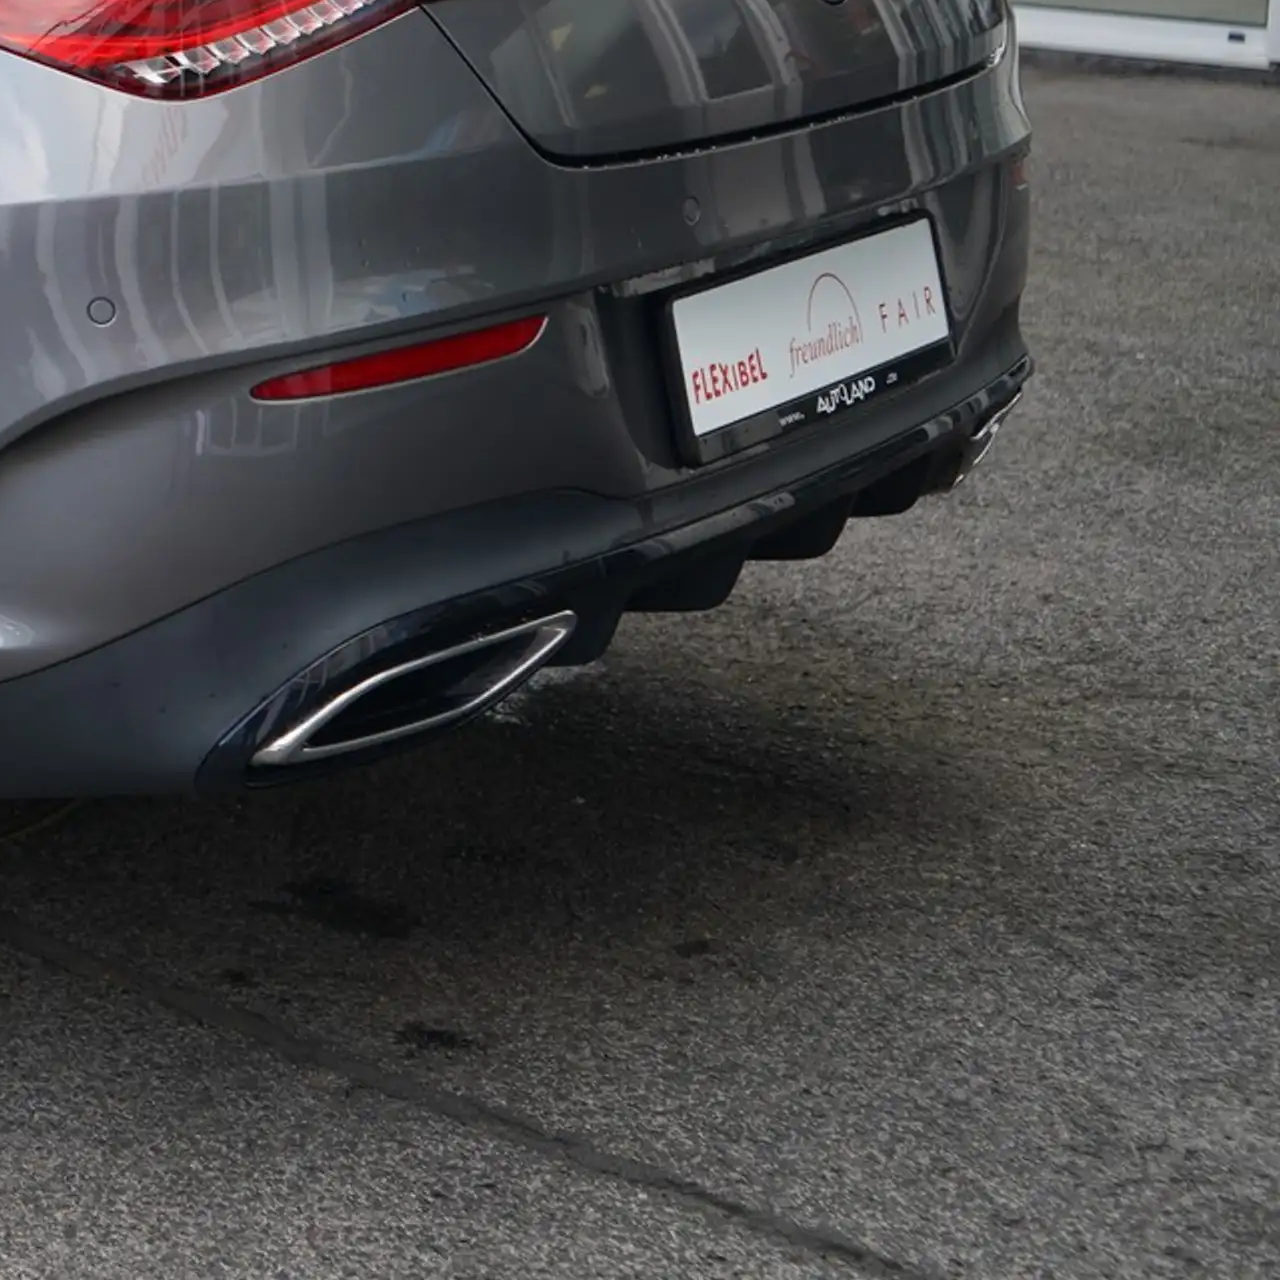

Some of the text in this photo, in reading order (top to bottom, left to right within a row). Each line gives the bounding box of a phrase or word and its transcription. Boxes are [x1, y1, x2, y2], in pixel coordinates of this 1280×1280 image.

[691, 285, 937, 405] FLEXIBEL freundlich FAIR
[815, 375, 877, 415] AUTOLAND
